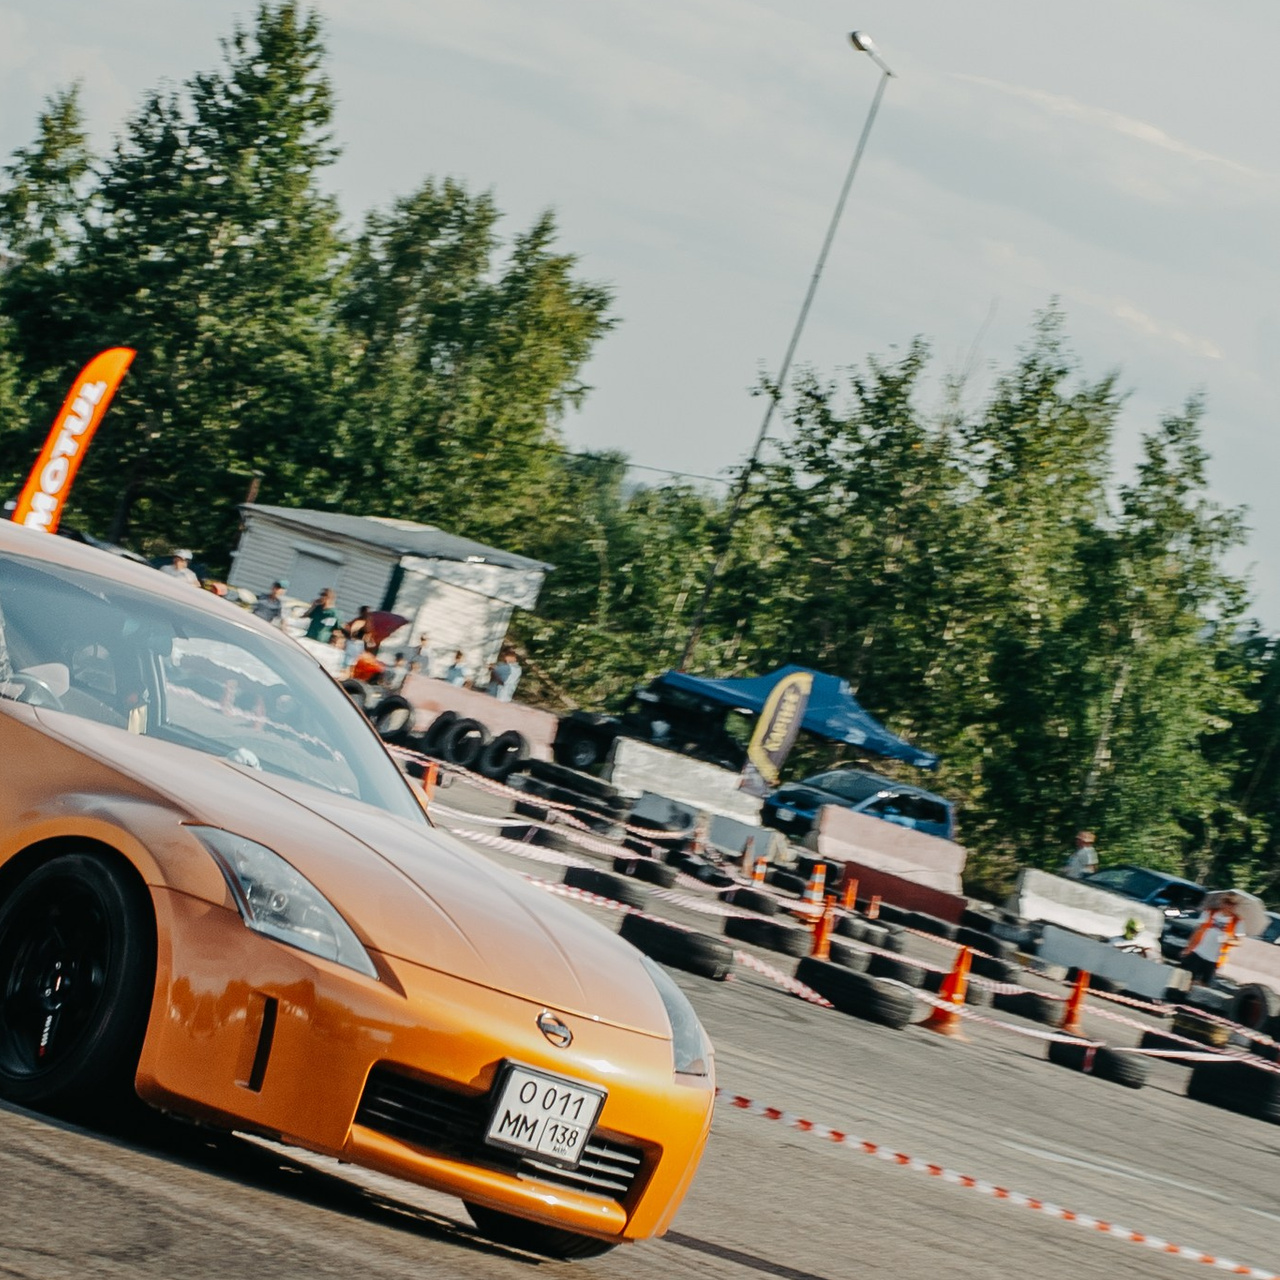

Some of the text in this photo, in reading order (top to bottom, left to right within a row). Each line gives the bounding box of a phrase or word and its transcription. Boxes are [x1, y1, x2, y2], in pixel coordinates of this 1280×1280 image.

[23, 380, 108, 533] MOTUL
[542, 1087, 586, 1120] 011
[549, 1124, 579, 1148] 138
